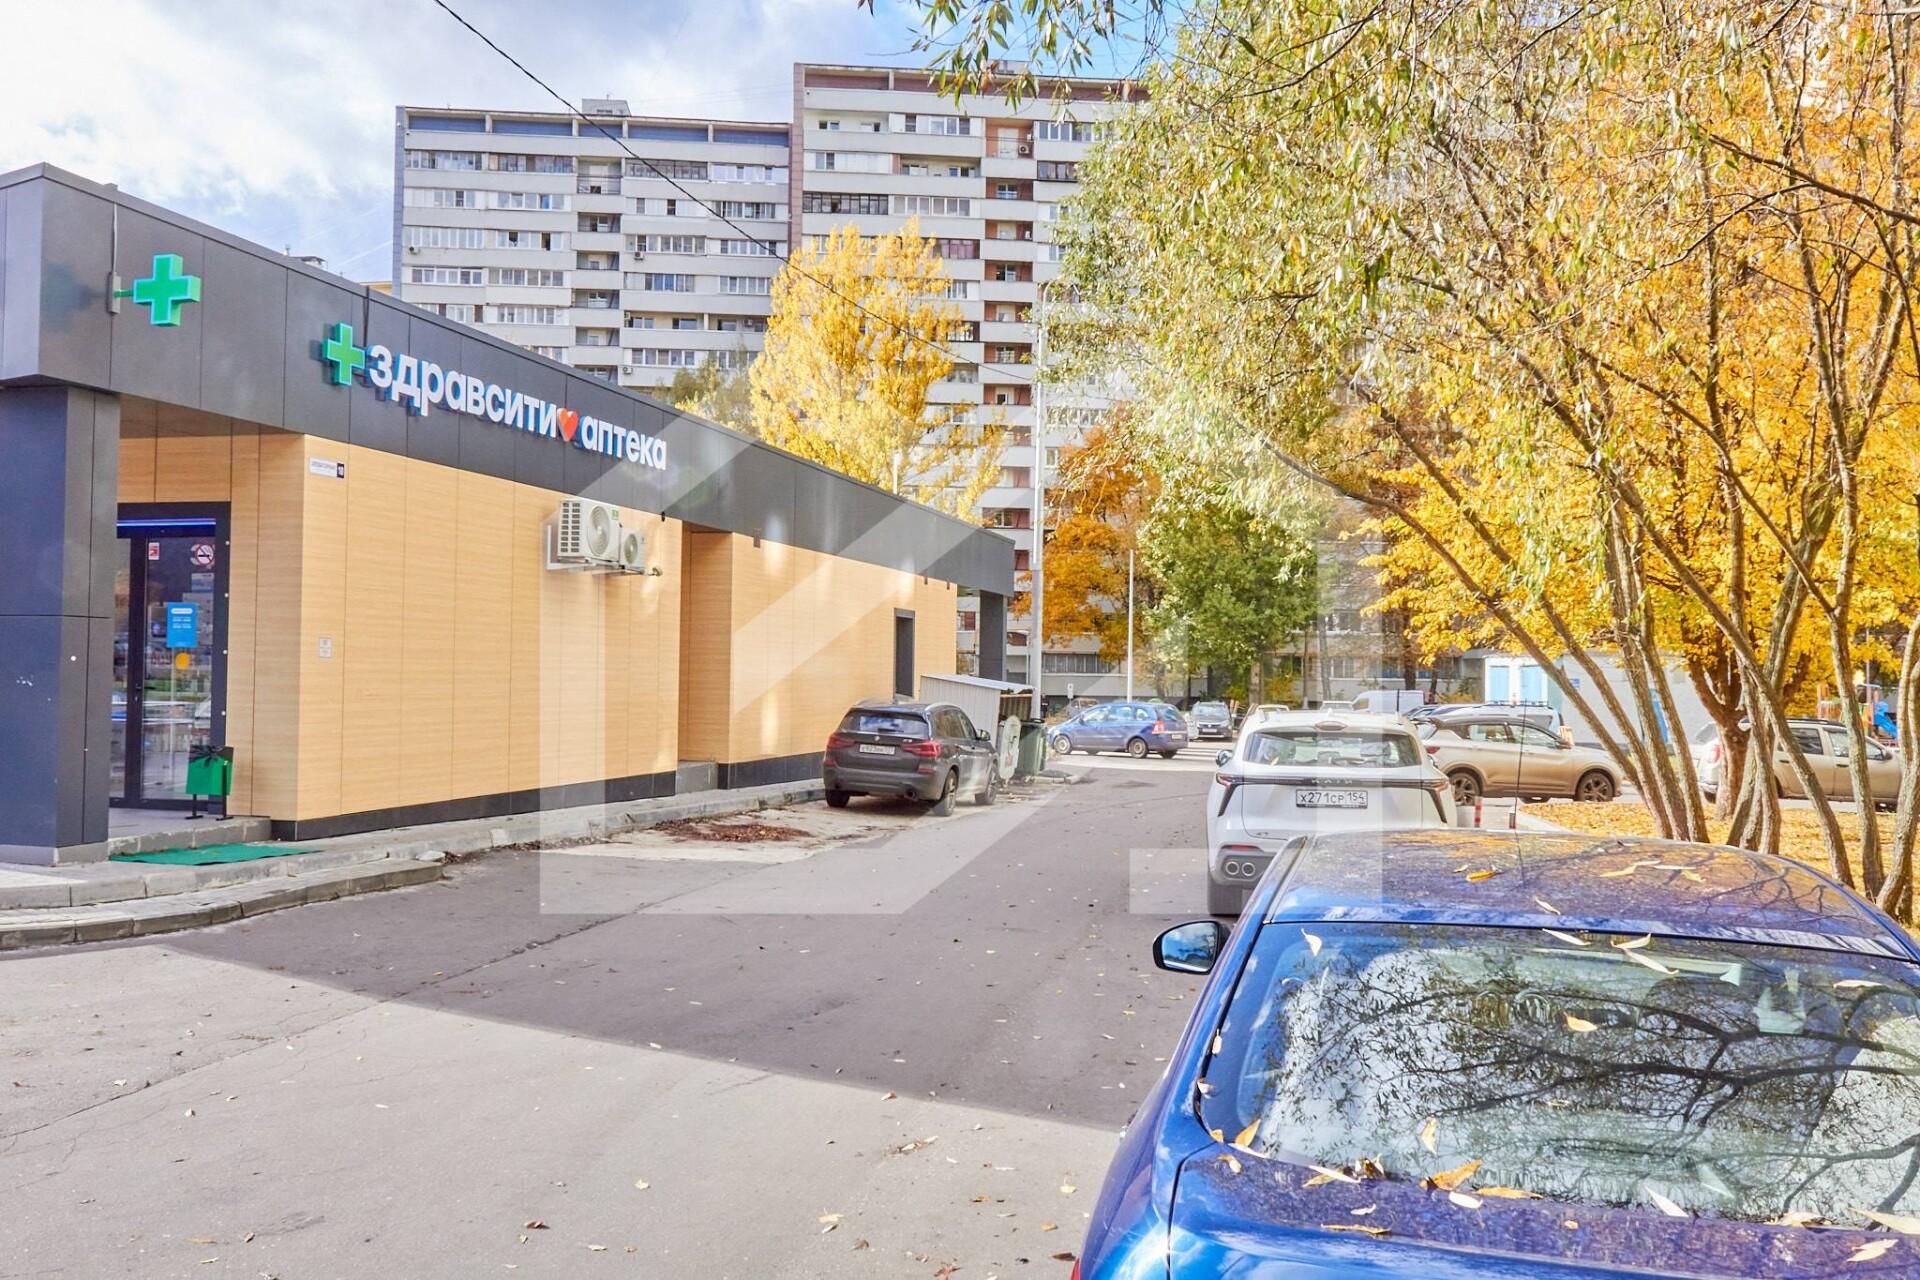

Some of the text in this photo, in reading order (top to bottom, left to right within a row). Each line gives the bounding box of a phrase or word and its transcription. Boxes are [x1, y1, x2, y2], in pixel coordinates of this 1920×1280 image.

[369, 344, 667, 470] здравсити аптека
[1347, 791, 1365, 802] 154
